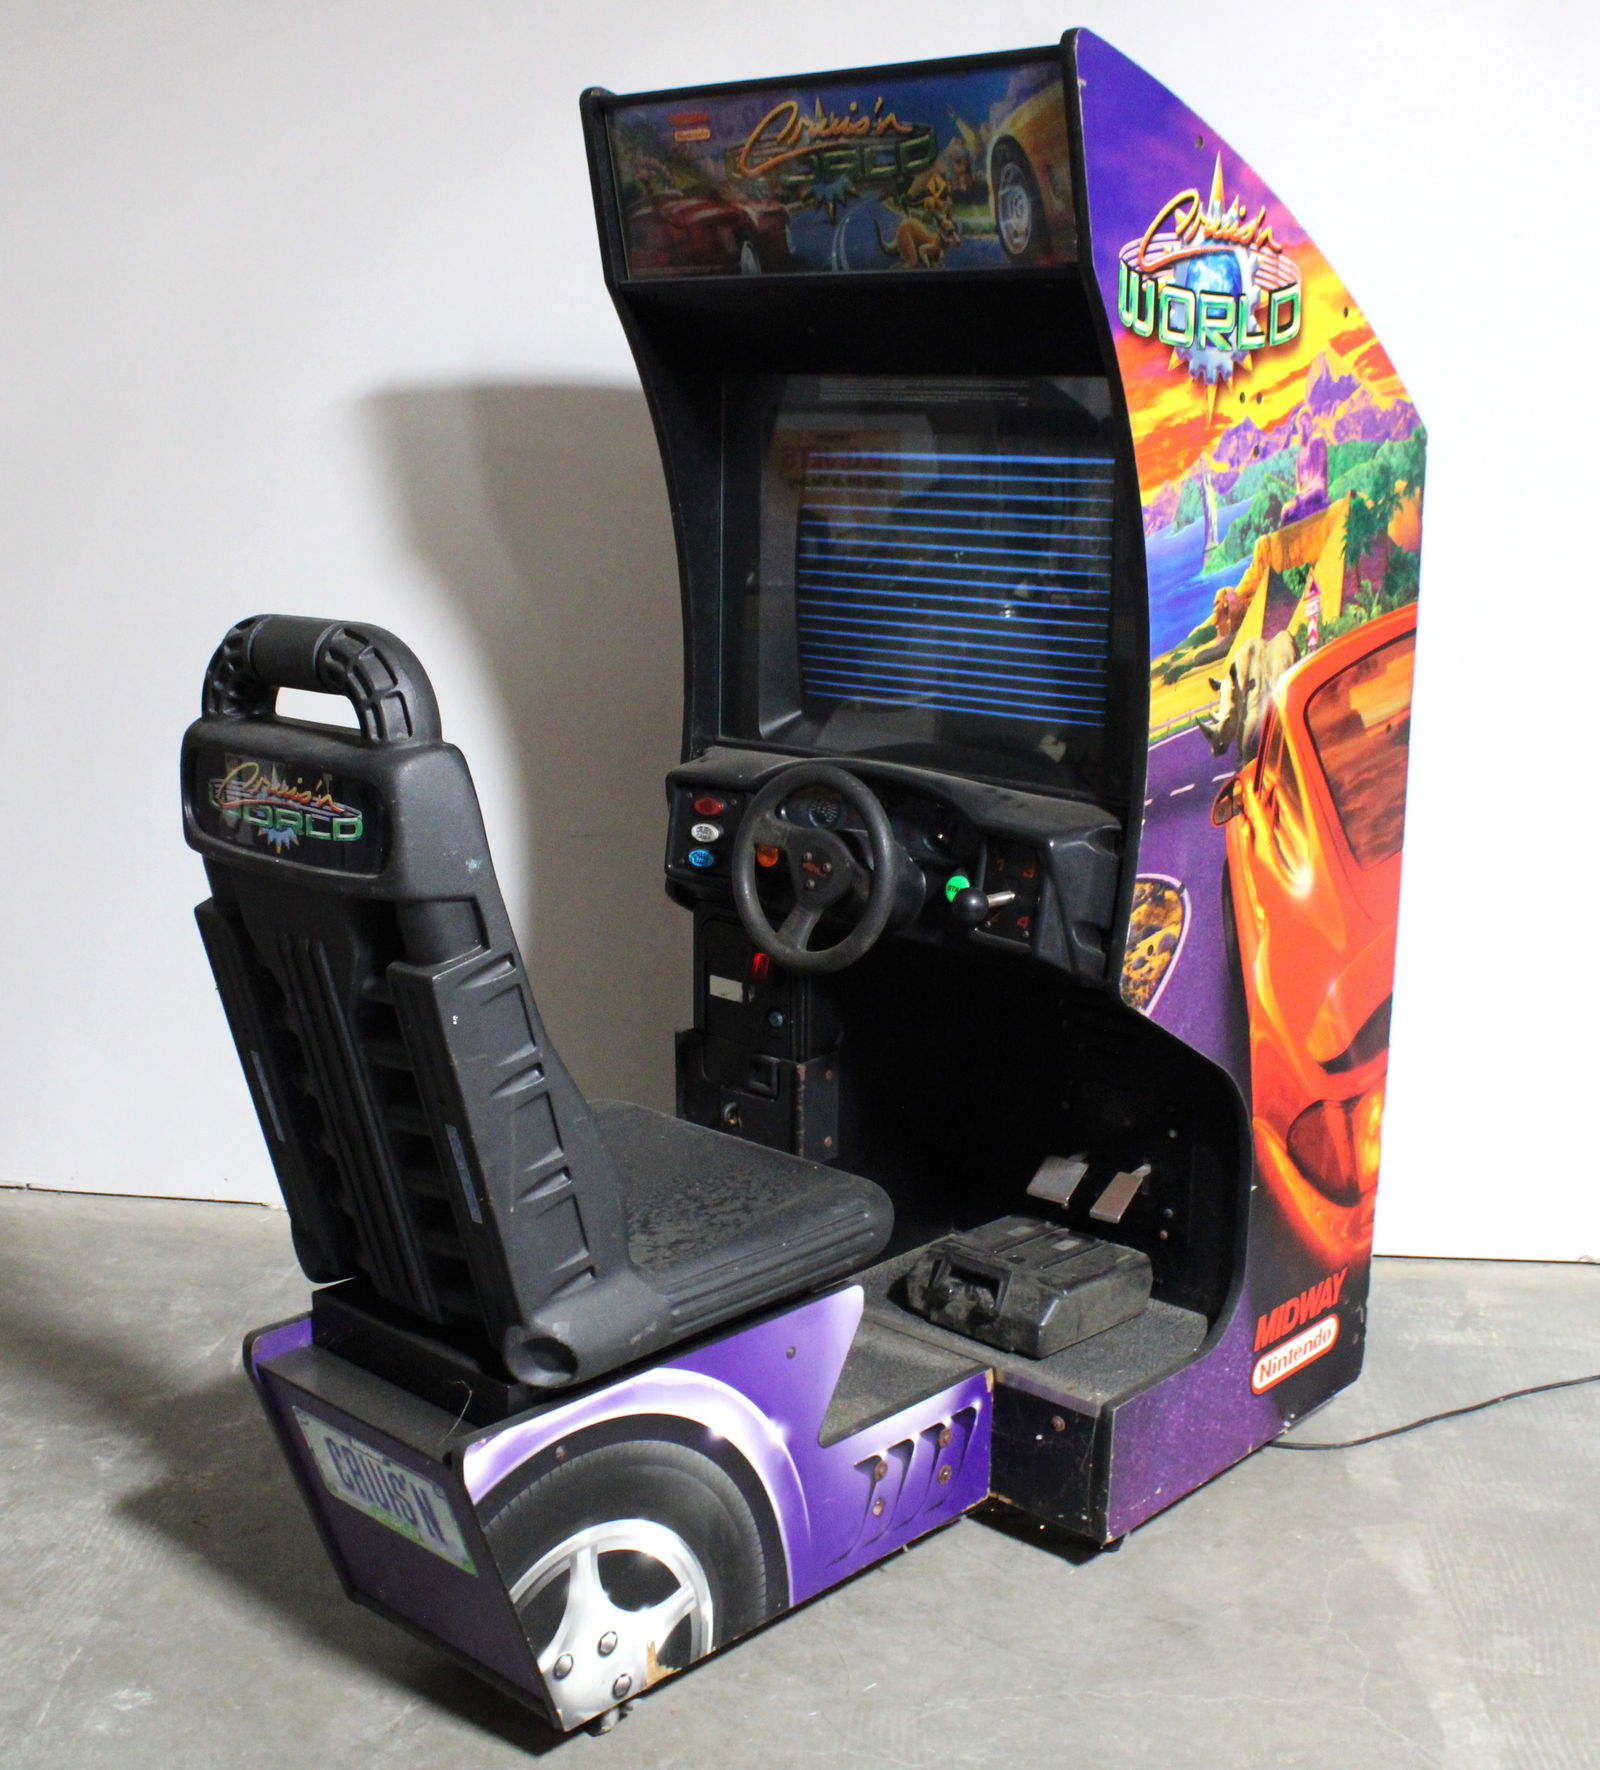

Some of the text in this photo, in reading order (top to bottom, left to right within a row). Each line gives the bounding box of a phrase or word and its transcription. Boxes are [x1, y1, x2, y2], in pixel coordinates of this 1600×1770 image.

[1138, 188, 1283, 272] Cruis'n
[1117, 258, 1302, 352] WORLD
[1253, 1267, 1348, 1353] MIDWAY
[1258, 1327, 1332, 1383] Nintendo
